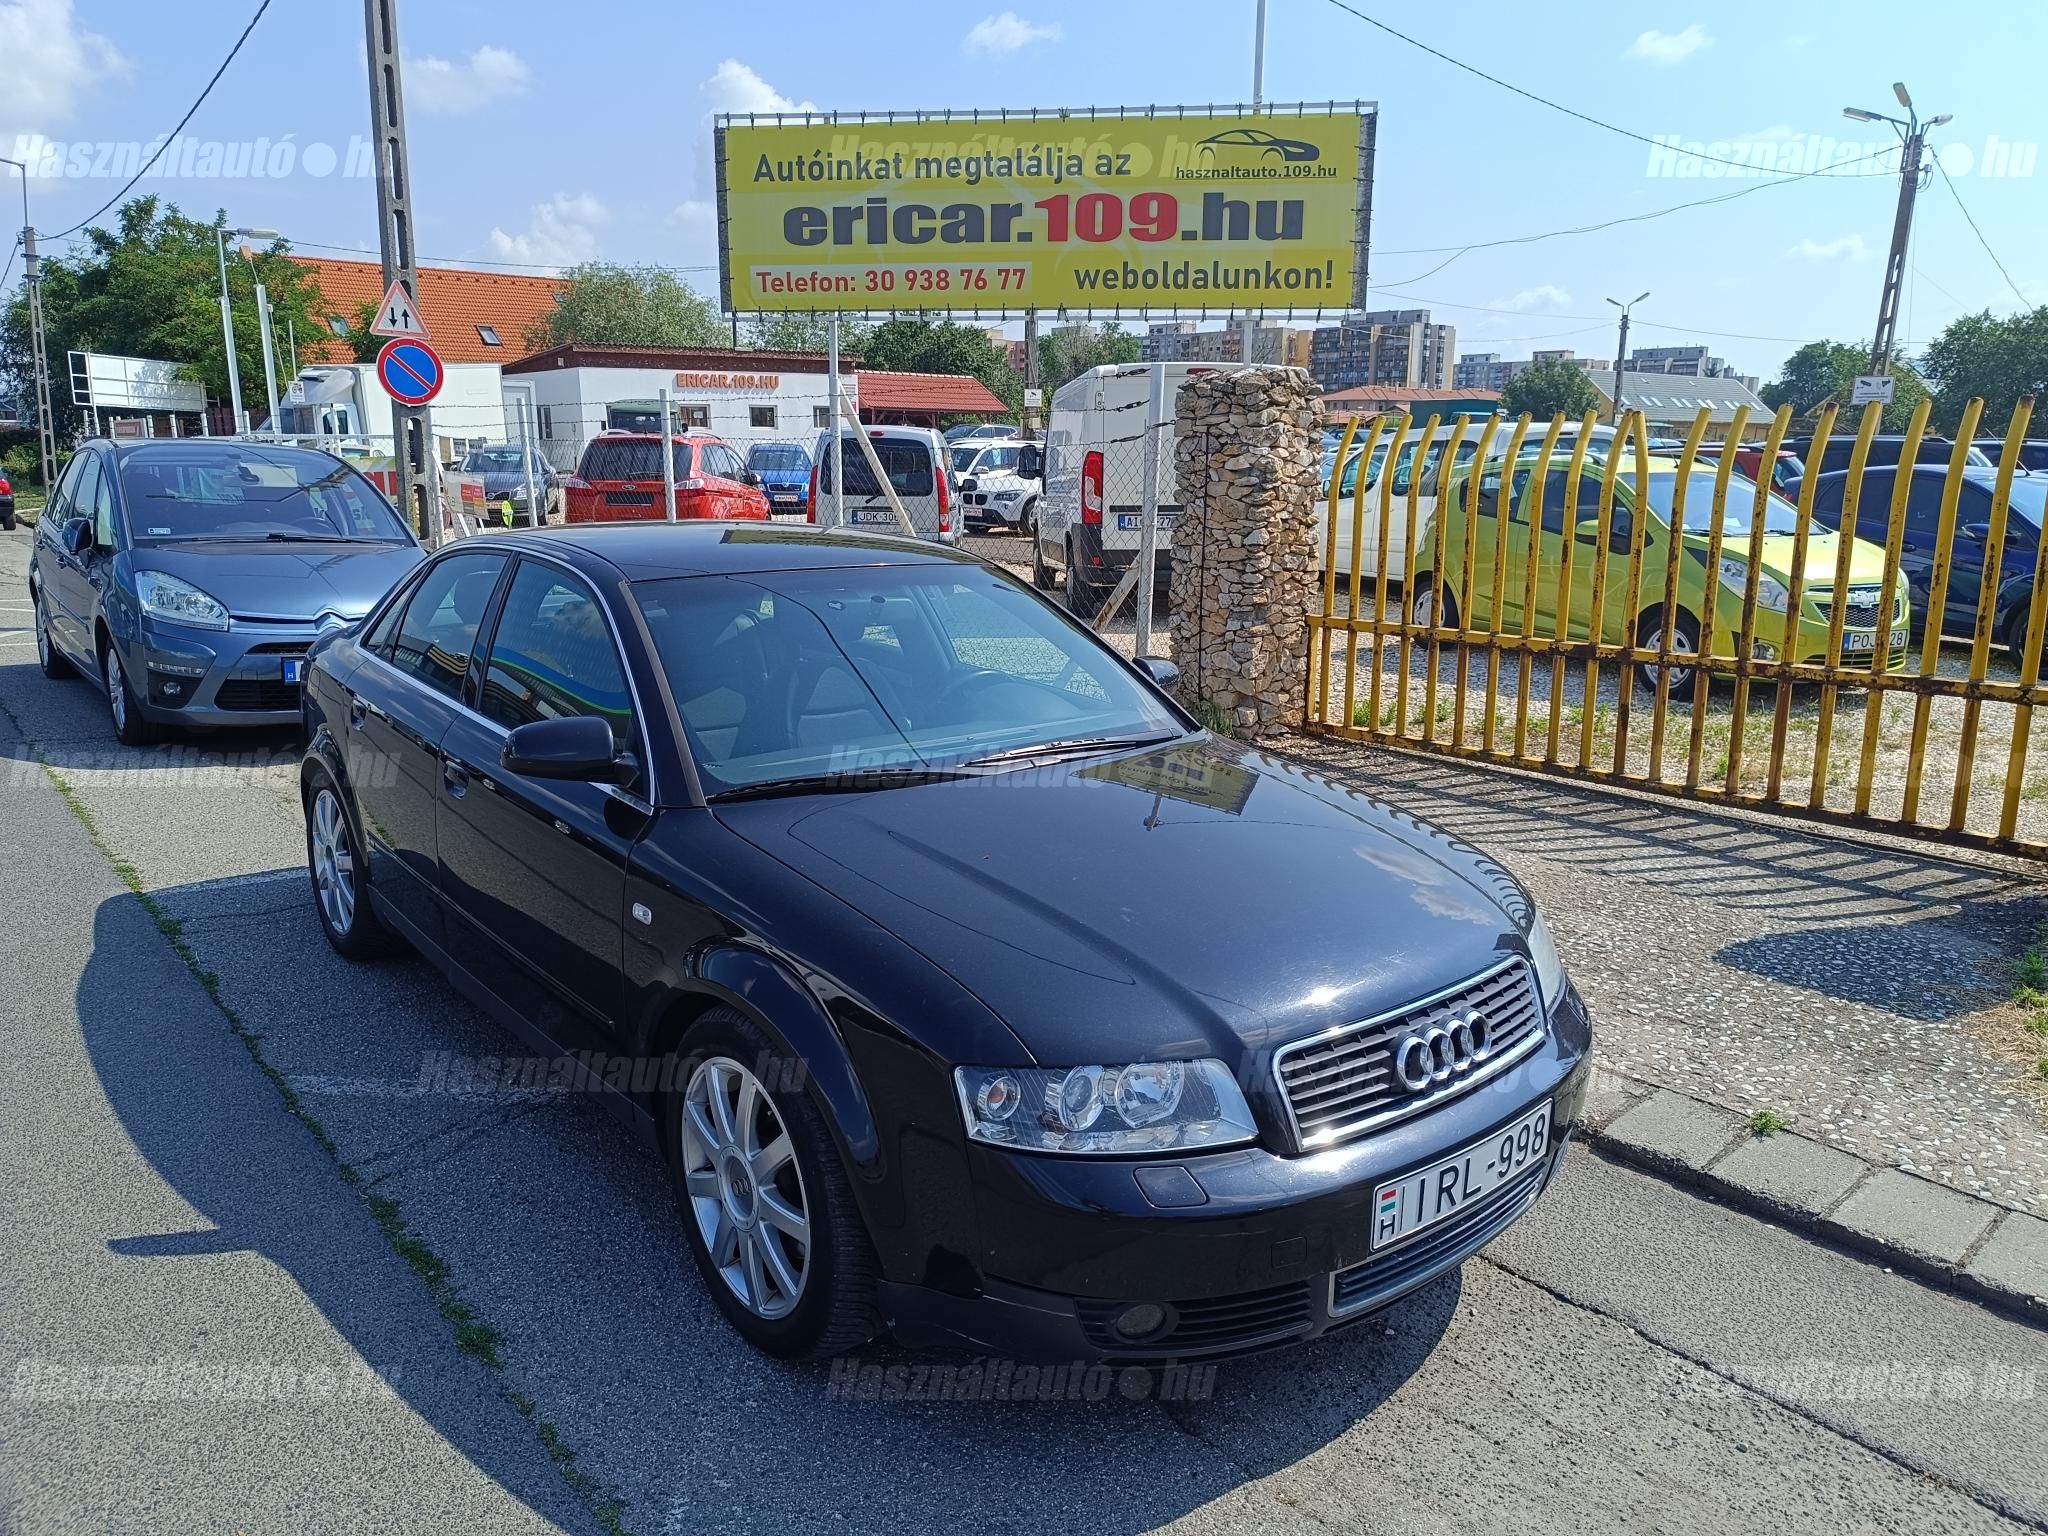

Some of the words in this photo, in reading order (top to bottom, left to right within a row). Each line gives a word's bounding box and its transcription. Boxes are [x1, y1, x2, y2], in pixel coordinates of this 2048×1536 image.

[754, 148, 903, 183] Autóinkat
[914, 144, 1084, 186] megtalálja
[1094, 153, 1132, 176] az
[1175, 165, 1337, 180] hasznaltauto.109.hu
[783, 191, 1305, 247] ericar.109.hu
[756, 271, 856, 293] Telefon:
[865, 270, 895, 292] 30
[904, 269, 950, 291] 938
[959, 268, 988, 290] 76
[997, 268, 1026, 290] 77
[1073, 260, 1333, 289] weboldalunkon!
[675, 373, 780, 389] ERICAR.109.HU
[1416, 1112, 1546, 1223] IRL-998
[1379, 1212, 1397, 1240] H
